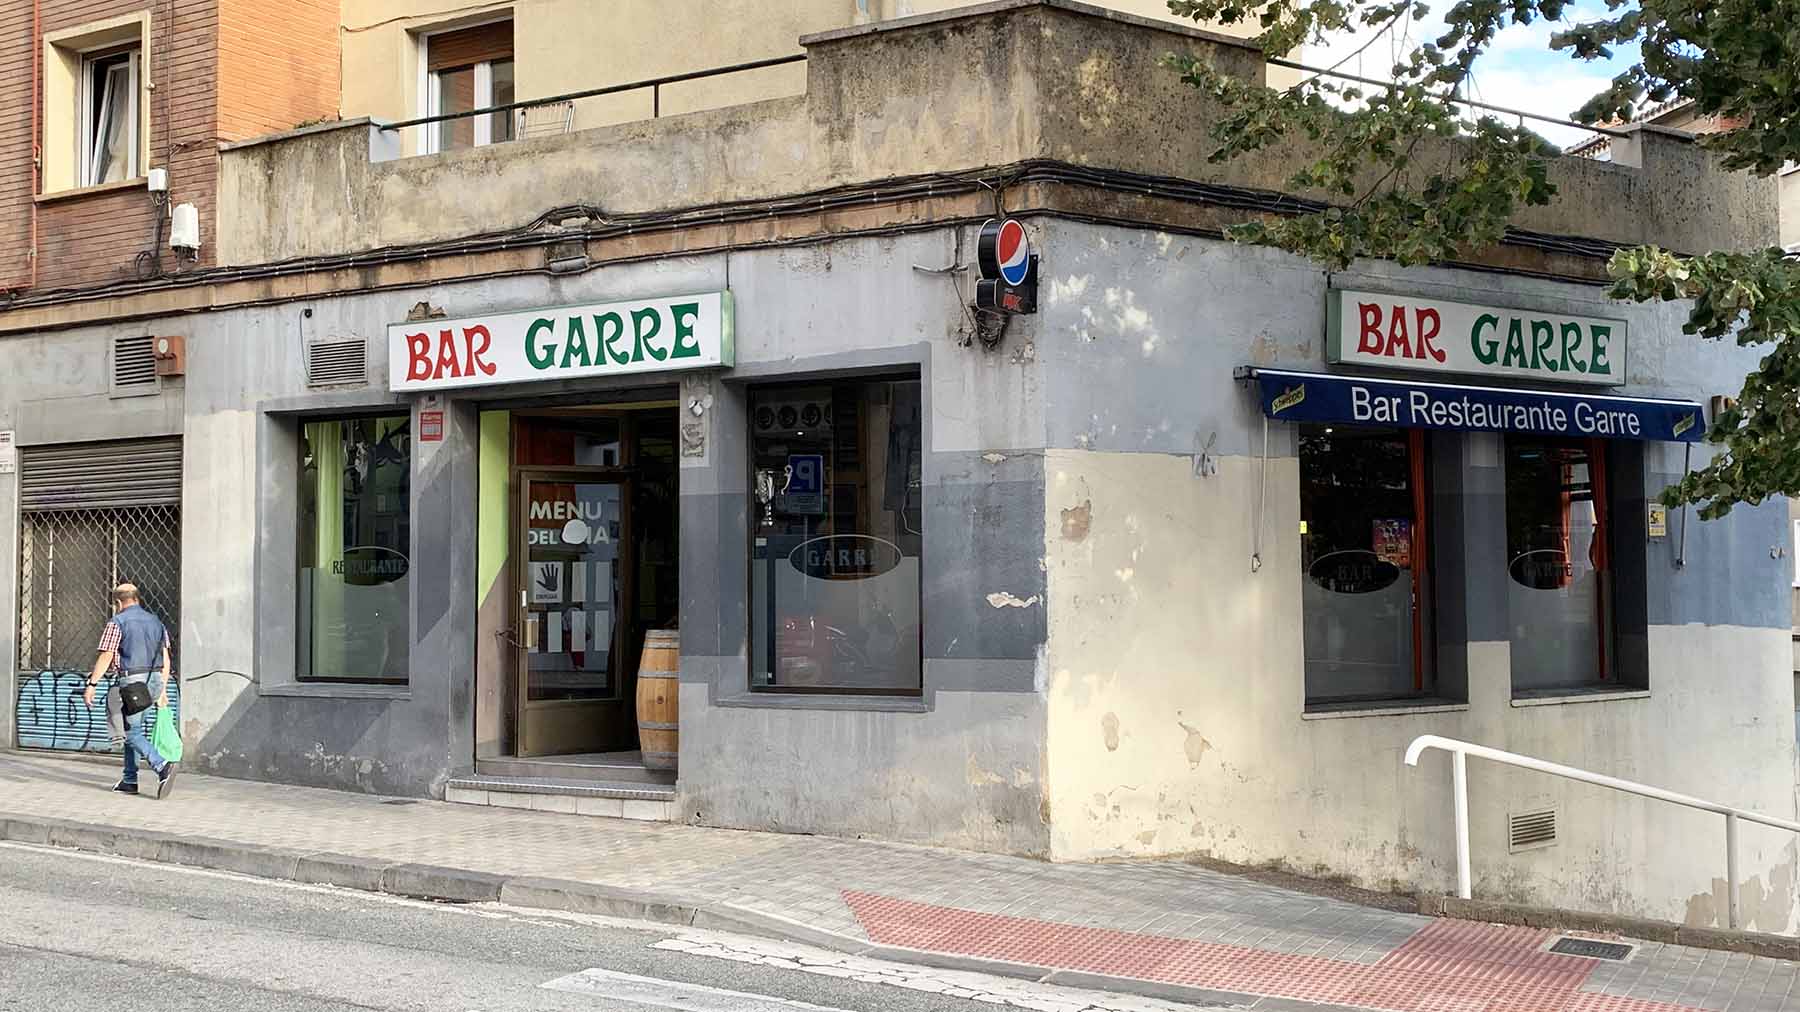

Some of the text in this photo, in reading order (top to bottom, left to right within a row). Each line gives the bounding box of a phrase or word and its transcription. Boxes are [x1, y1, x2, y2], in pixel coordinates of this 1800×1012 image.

[405, 303, 701, 382] BAR GARRE
[1356, 301, 1612, 375] BAR GARRE
[1351, 386, 1401, 423] Bar
[1409, 390, 1568, 433] Restaurante
[1574, 401, 1641, 435] Garre
[530, 500, 602, 520] MENU
[528, 530, 558, 545] DEL
[1522, 561, 1573, 577] GARE
